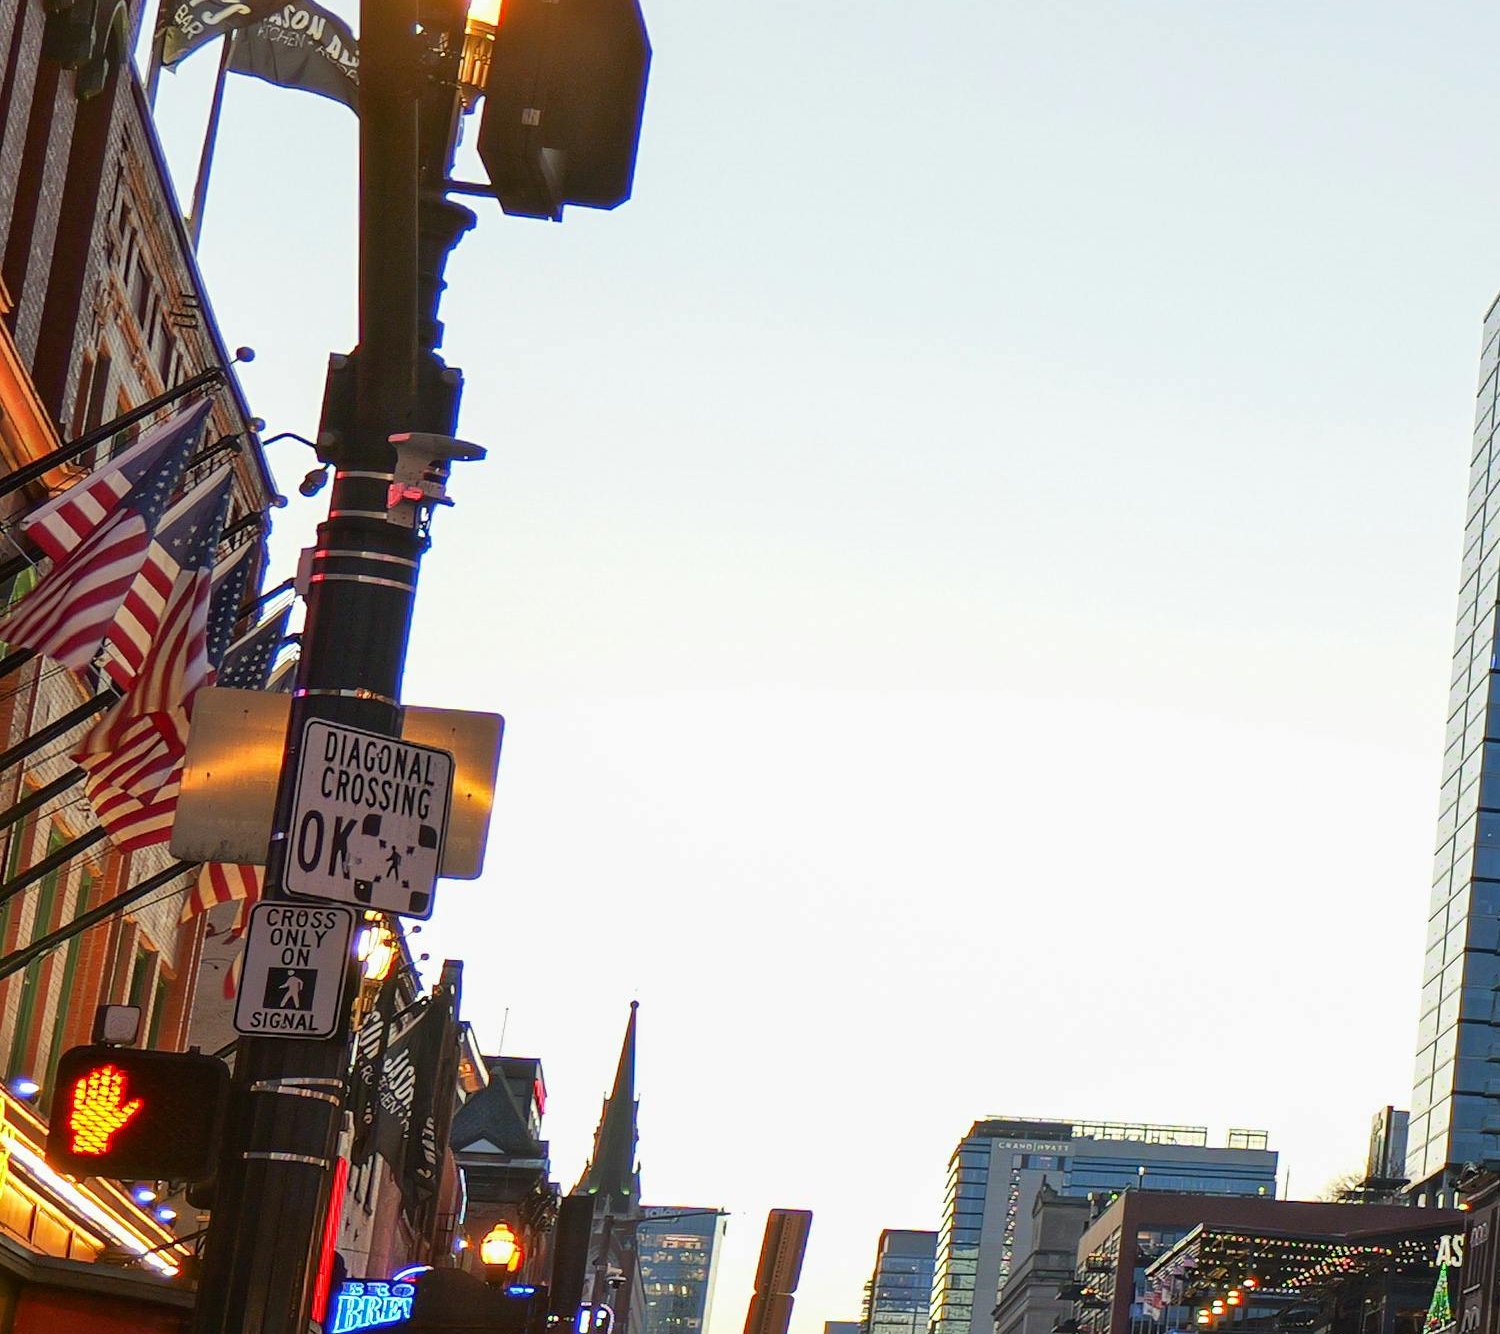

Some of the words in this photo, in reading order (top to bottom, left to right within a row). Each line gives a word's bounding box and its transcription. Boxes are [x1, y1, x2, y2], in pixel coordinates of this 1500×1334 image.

[174, 4, 204, 41] BAR
[324, 731, 435, 788] DIAGONAL
[320, 766, 433, 820] CROSSING
[297, 809, 358, 881] OK
[265, 908, 337, 930] CROSS
[270, 927, 329, 950] ONLY
[281, 947, 311, 967] ON
[250, 1011, 320, 1032] SIGNAL
